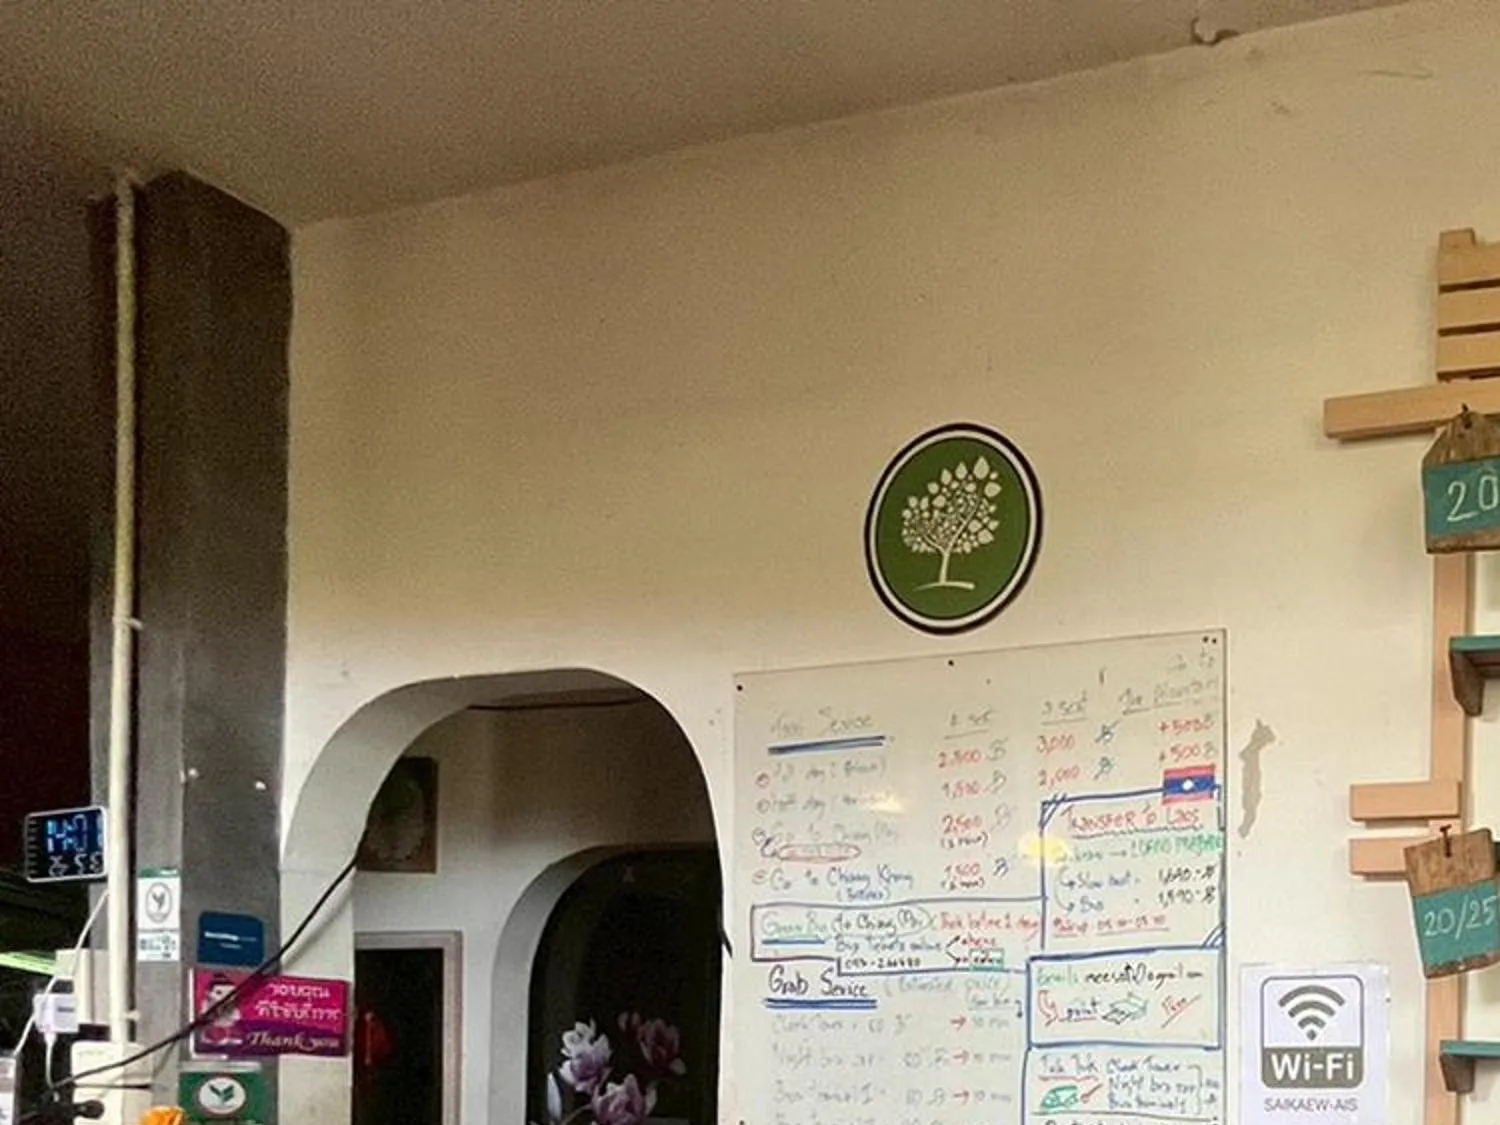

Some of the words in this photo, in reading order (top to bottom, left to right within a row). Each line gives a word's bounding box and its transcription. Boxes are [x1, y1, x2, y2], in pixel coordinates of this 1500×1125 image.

[1446, 468, 1500, 523] 20
[1423, 894, 1498, 939] 20/25
[768, 964, 809, 995] Grab
[249, 1030, 304, 1048] Thank
[1270, 1053, 1354, 1081] Wi-Fi
[1264, 1097, 1359, 1113] SAIKAEW-AIS
